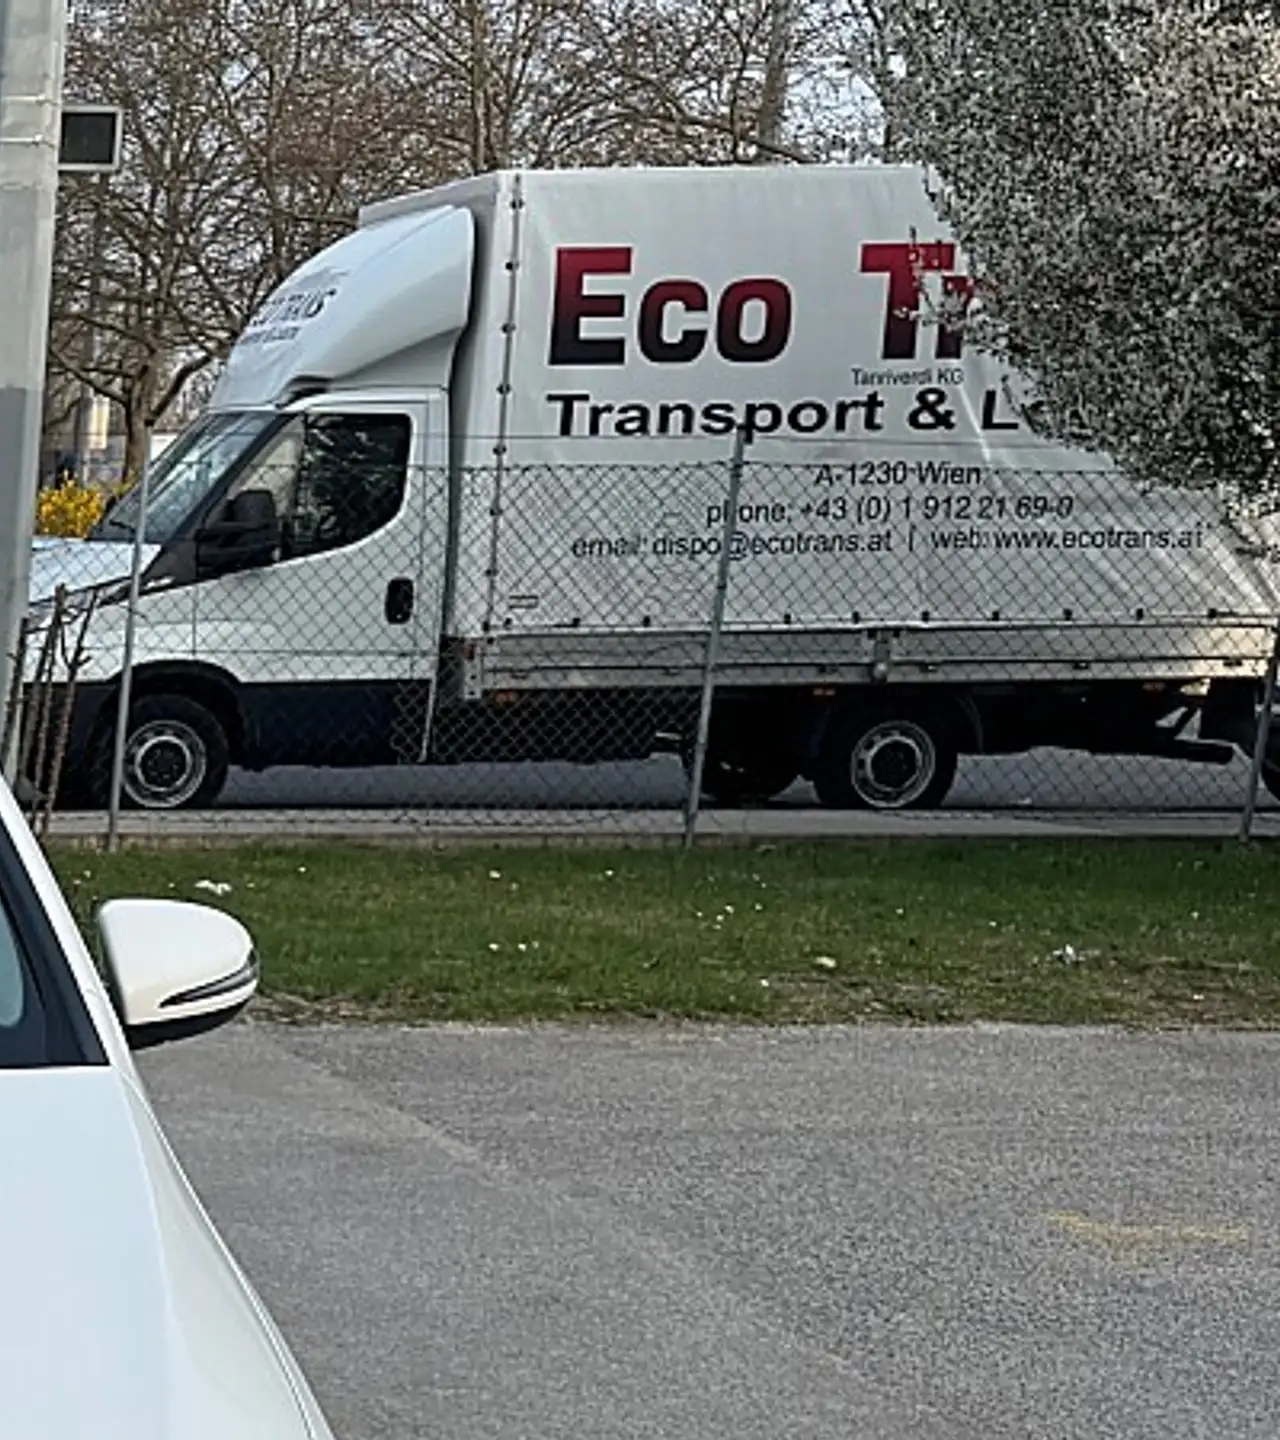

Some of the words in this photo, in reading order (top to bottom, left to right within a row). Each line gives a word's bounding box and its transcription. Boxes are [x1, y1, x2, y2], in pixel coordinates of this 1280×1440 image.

[548, 246, 792, 366] Eco
[547, 391, 884, 444] Transport
[908, 387, 956, 430] &
[814, 461, 907, 486] A-1230
[916, 460, 981, 486] Wien
[801, 497, 846, 521] +43
[857, 496, 890, 523] (0)
[923, 495, 972, 520] 912
[978, 496, 1007, 520] 21
